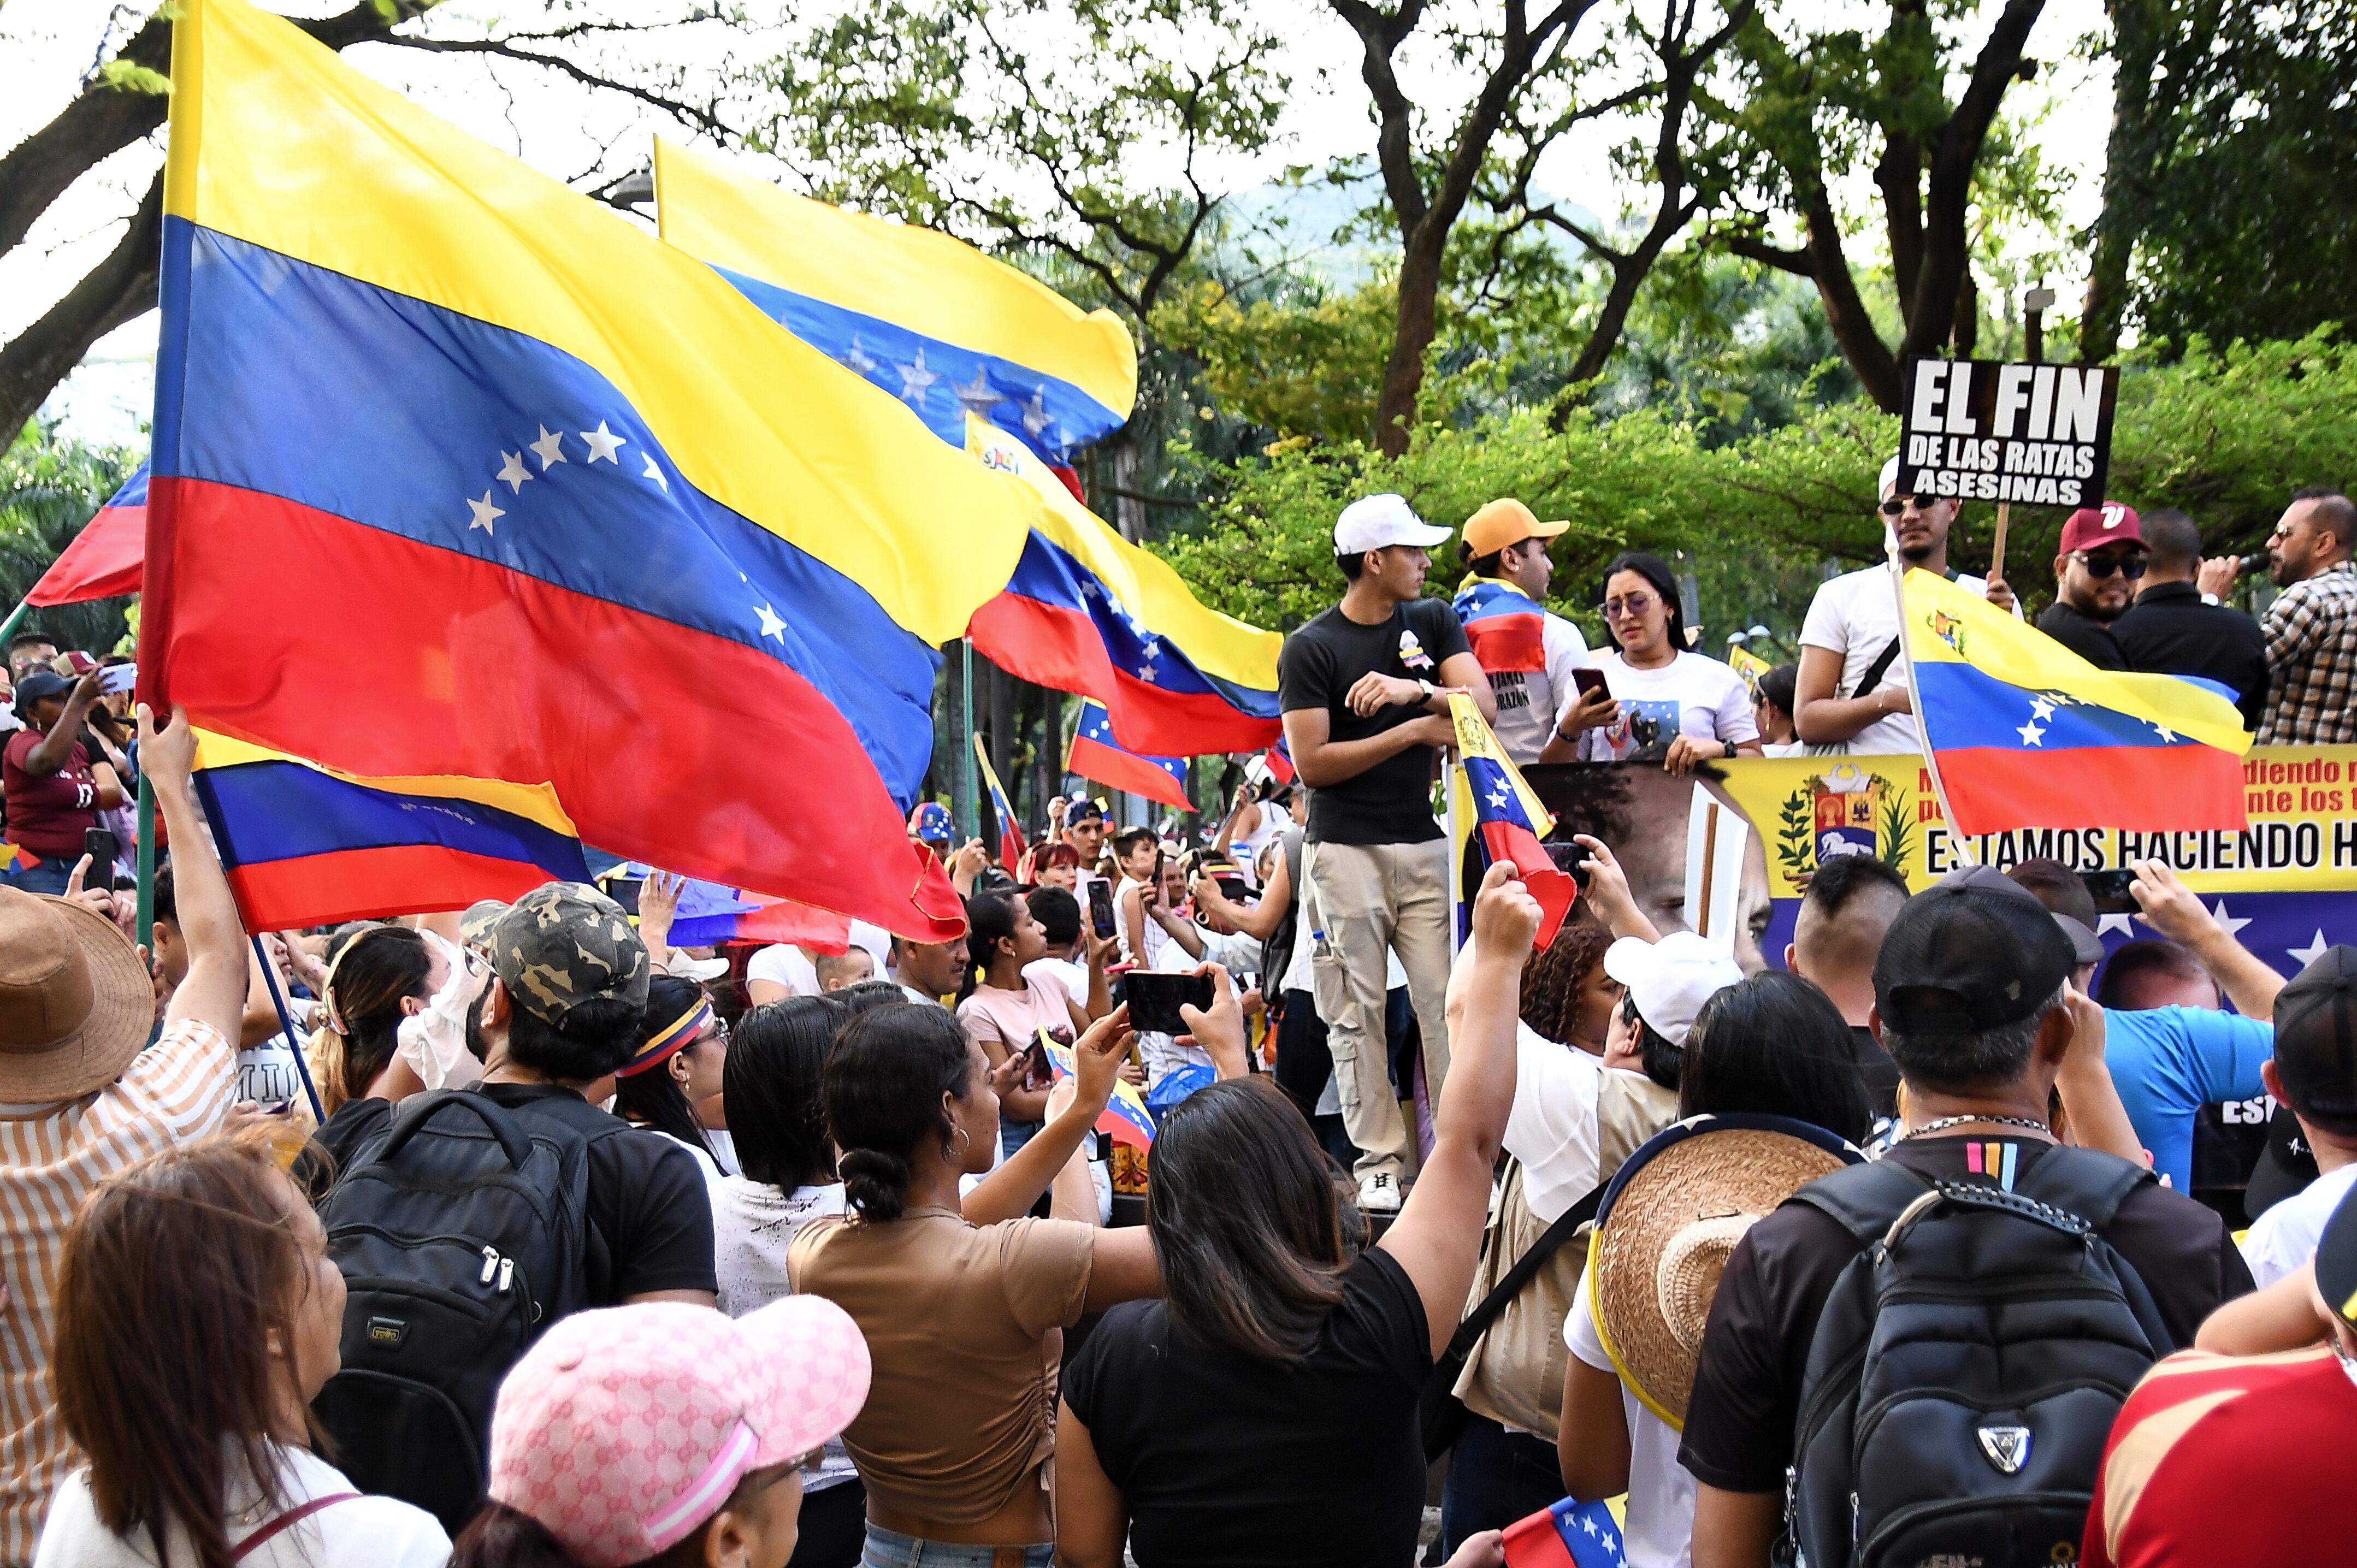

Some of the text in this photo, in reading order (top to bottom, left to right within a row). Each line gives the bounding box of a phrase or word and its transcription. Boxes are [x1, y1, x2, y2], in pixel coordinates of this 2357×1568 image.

[1910, 359, 2104, 443] EL FIN
[1907, 434, 2095, 479] DE LAS RATAS
[1913, 468, 2082, 506] ASESINAS
[2301, 786, 2343, 813] los
[2119, 823, 2319, 869] HACIENDO
